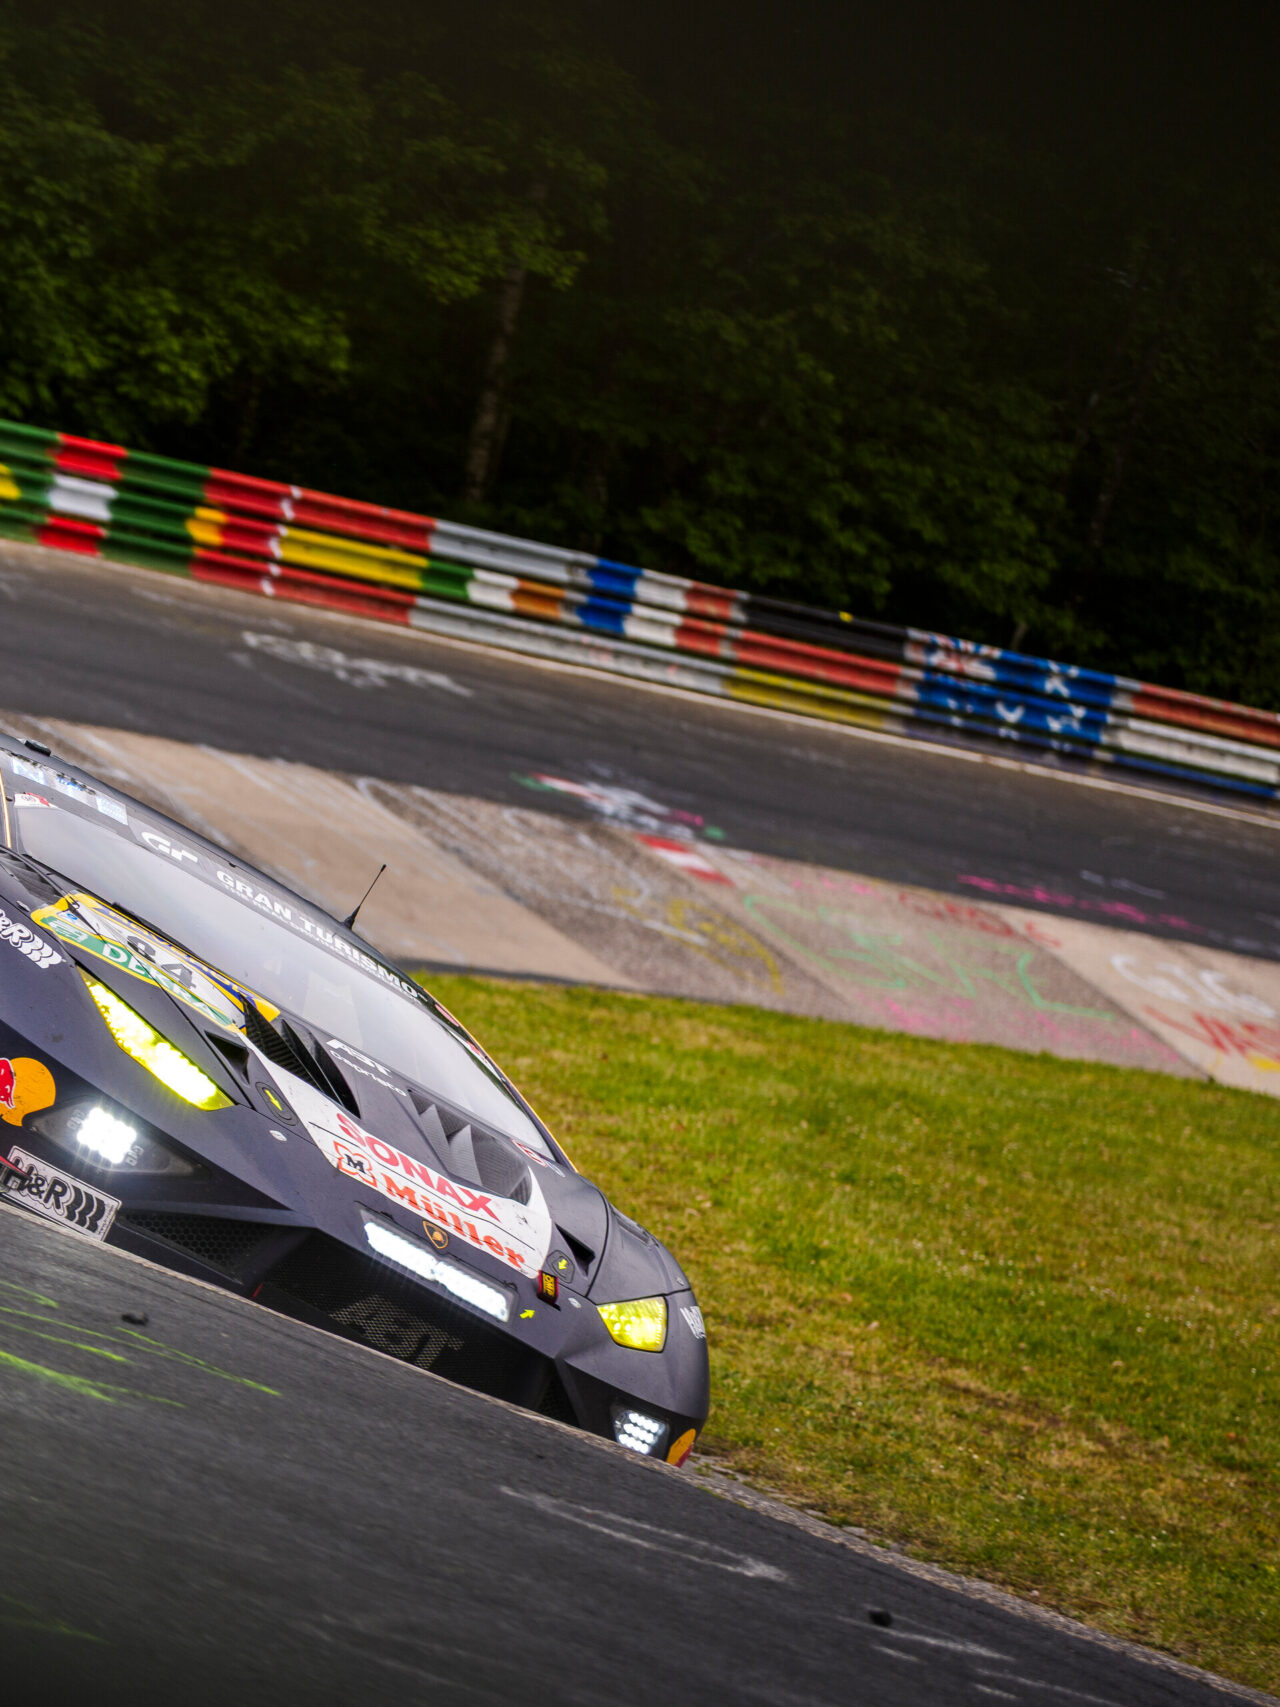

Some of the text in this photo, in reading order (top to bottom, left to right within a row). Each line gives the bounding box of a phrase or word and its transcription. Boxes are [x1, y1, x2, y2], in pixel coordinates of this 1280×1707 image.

[216, 869, 419, 999] GRAN TURISMO
[336, 1113, 501, 1223] SONAX
[345, 1154, 366, 1174] M
[379, 1172, 526, 1269] Müller
